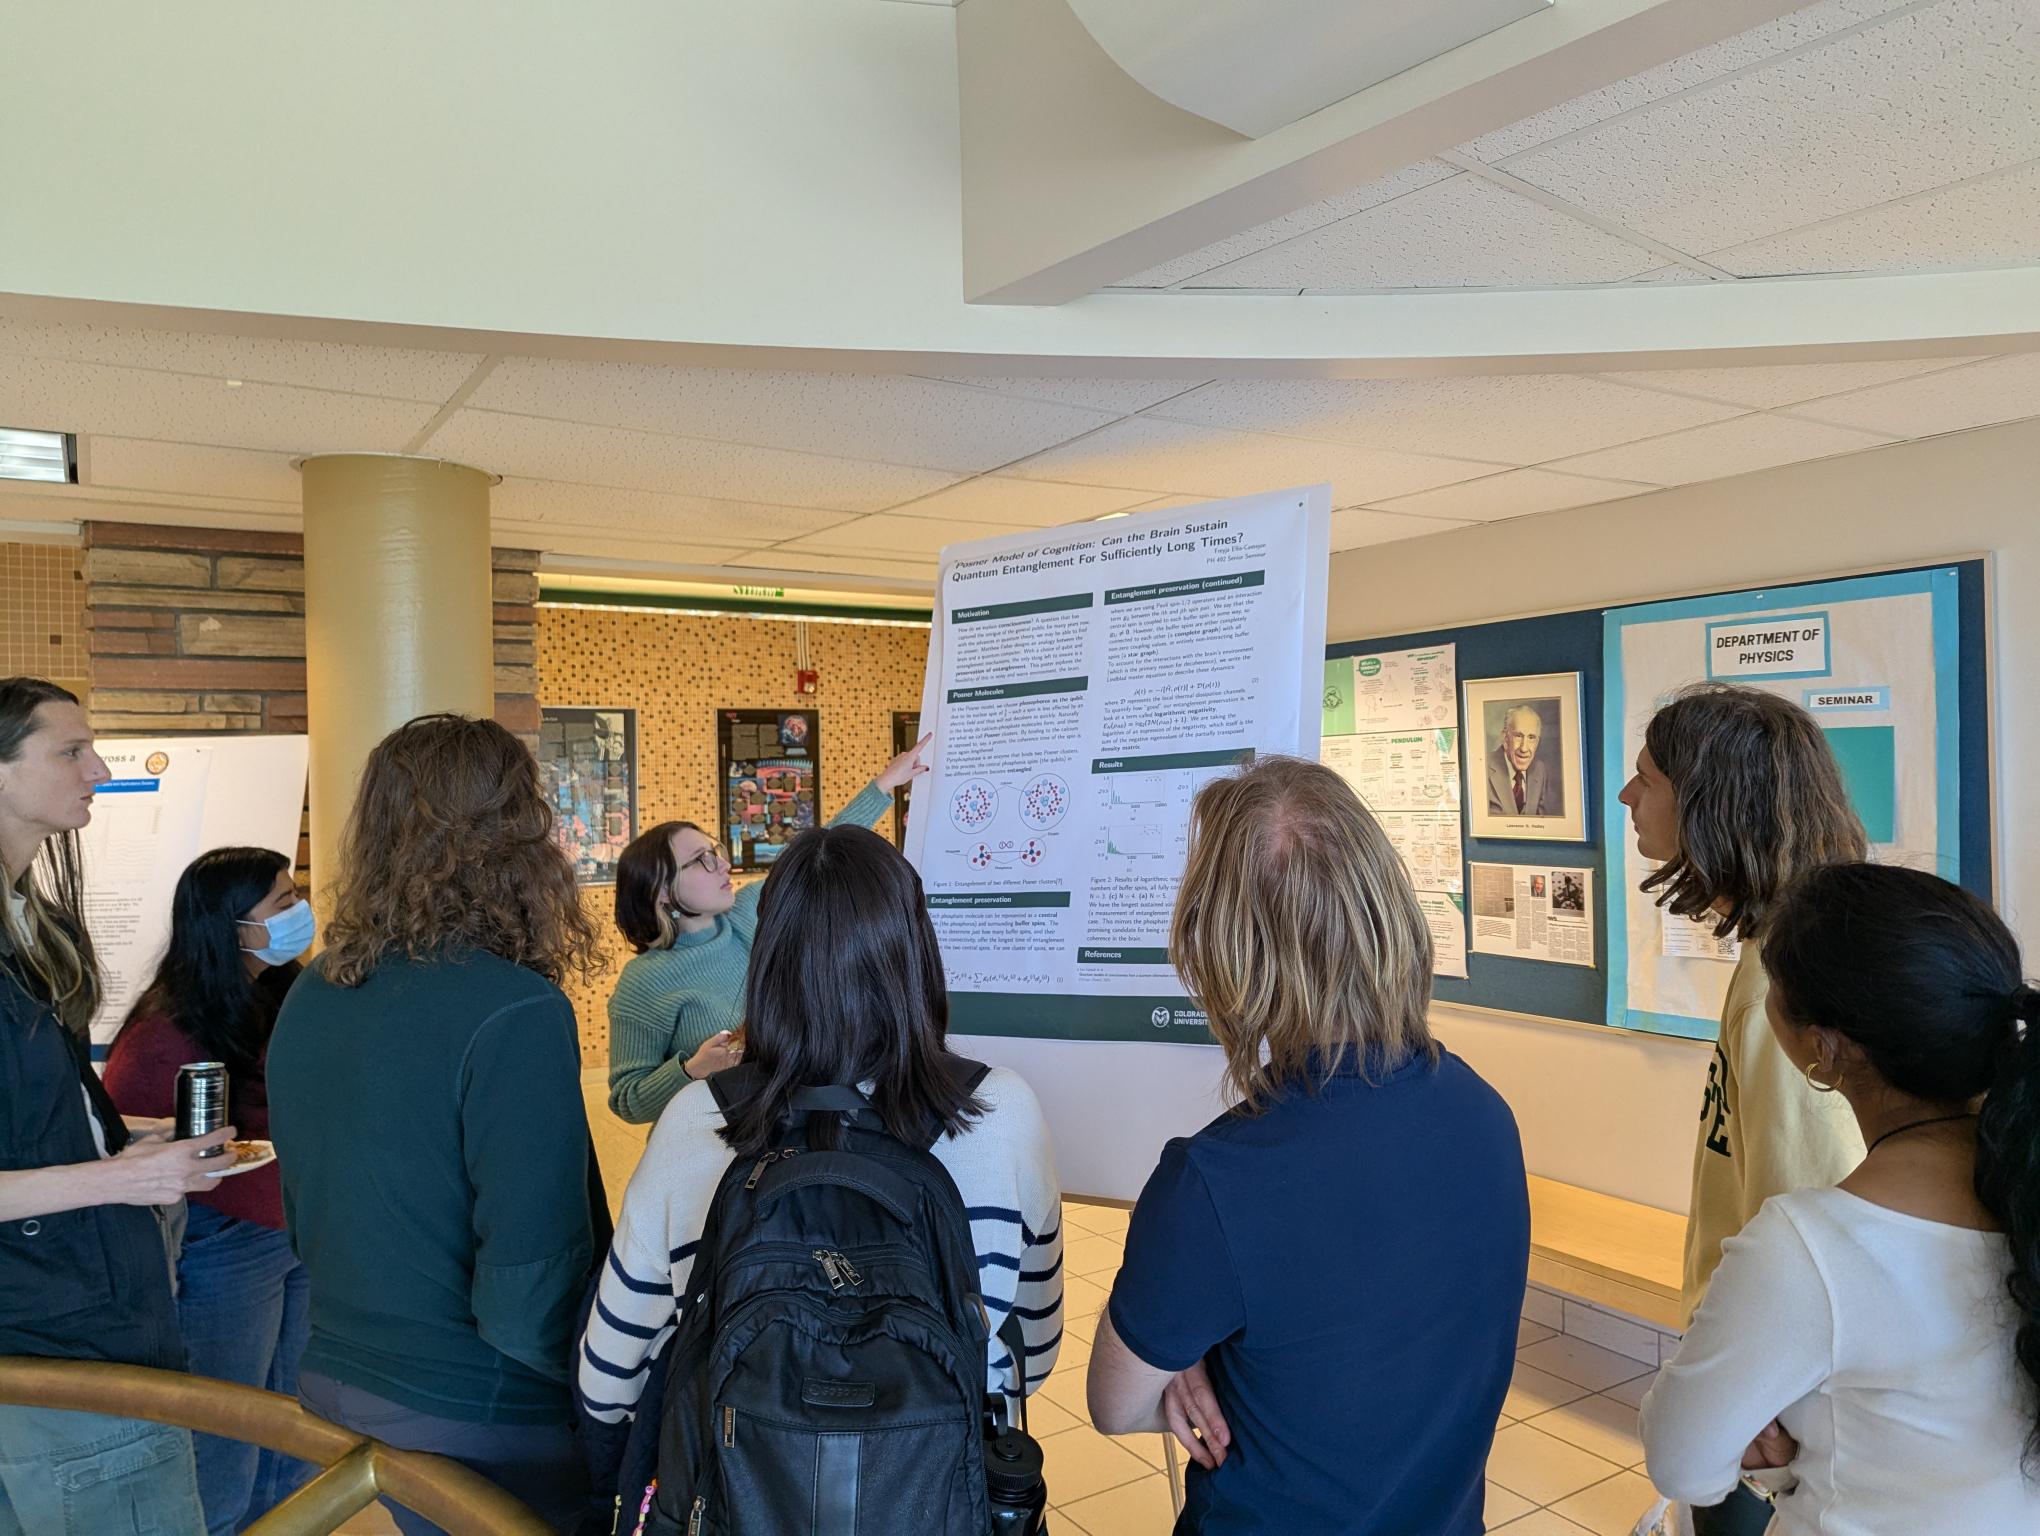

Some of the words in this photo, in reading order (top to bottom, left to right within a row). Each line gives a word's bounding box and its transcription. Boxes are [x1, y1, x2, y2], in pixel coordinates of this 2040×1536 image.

[955, 558, 988, 569] Posner
[992, 552, 1025, 563] Model
[1042, 541, 1095, 555] Cognition:
[1102, 537, 1123, 546] Can
[1127, 533, 1145, 542] the
[1150, 527, 1180, 539] Brain
[1185, 520, 1228, 534] Sustain
[952, 570, 998, 582] Quantum
[1002, 557, 1074, 575] Entanglement
[1079, 554, 1096, 564] For
[1100, 543, 1162, 561] Sufficiently
[1168, 541, 1196, 552] Long
[1201, 533, 1243, 547] Times?
[1111, 587, 1156, 600] Entanglement
[1158, 582, 1200, 595] preservation
[1202, 576, 1243, 589] (continued)
[958, 610, 990, 618] Motivation
[1716, 630, 1800, 648] DEPARTMENT
[1802, 629, 1820, 642] OF
[1739, 650, 1794, 664] PHYSICS
[1818, 695, 1873, 706] SEMINAR
[1391, 736, 1423, 744] PENDULUM
[1099, 761, 1123, 769] Results
[931, 897, 973, 905] Entanglement
[974, 896, 1012, 904] preservation
